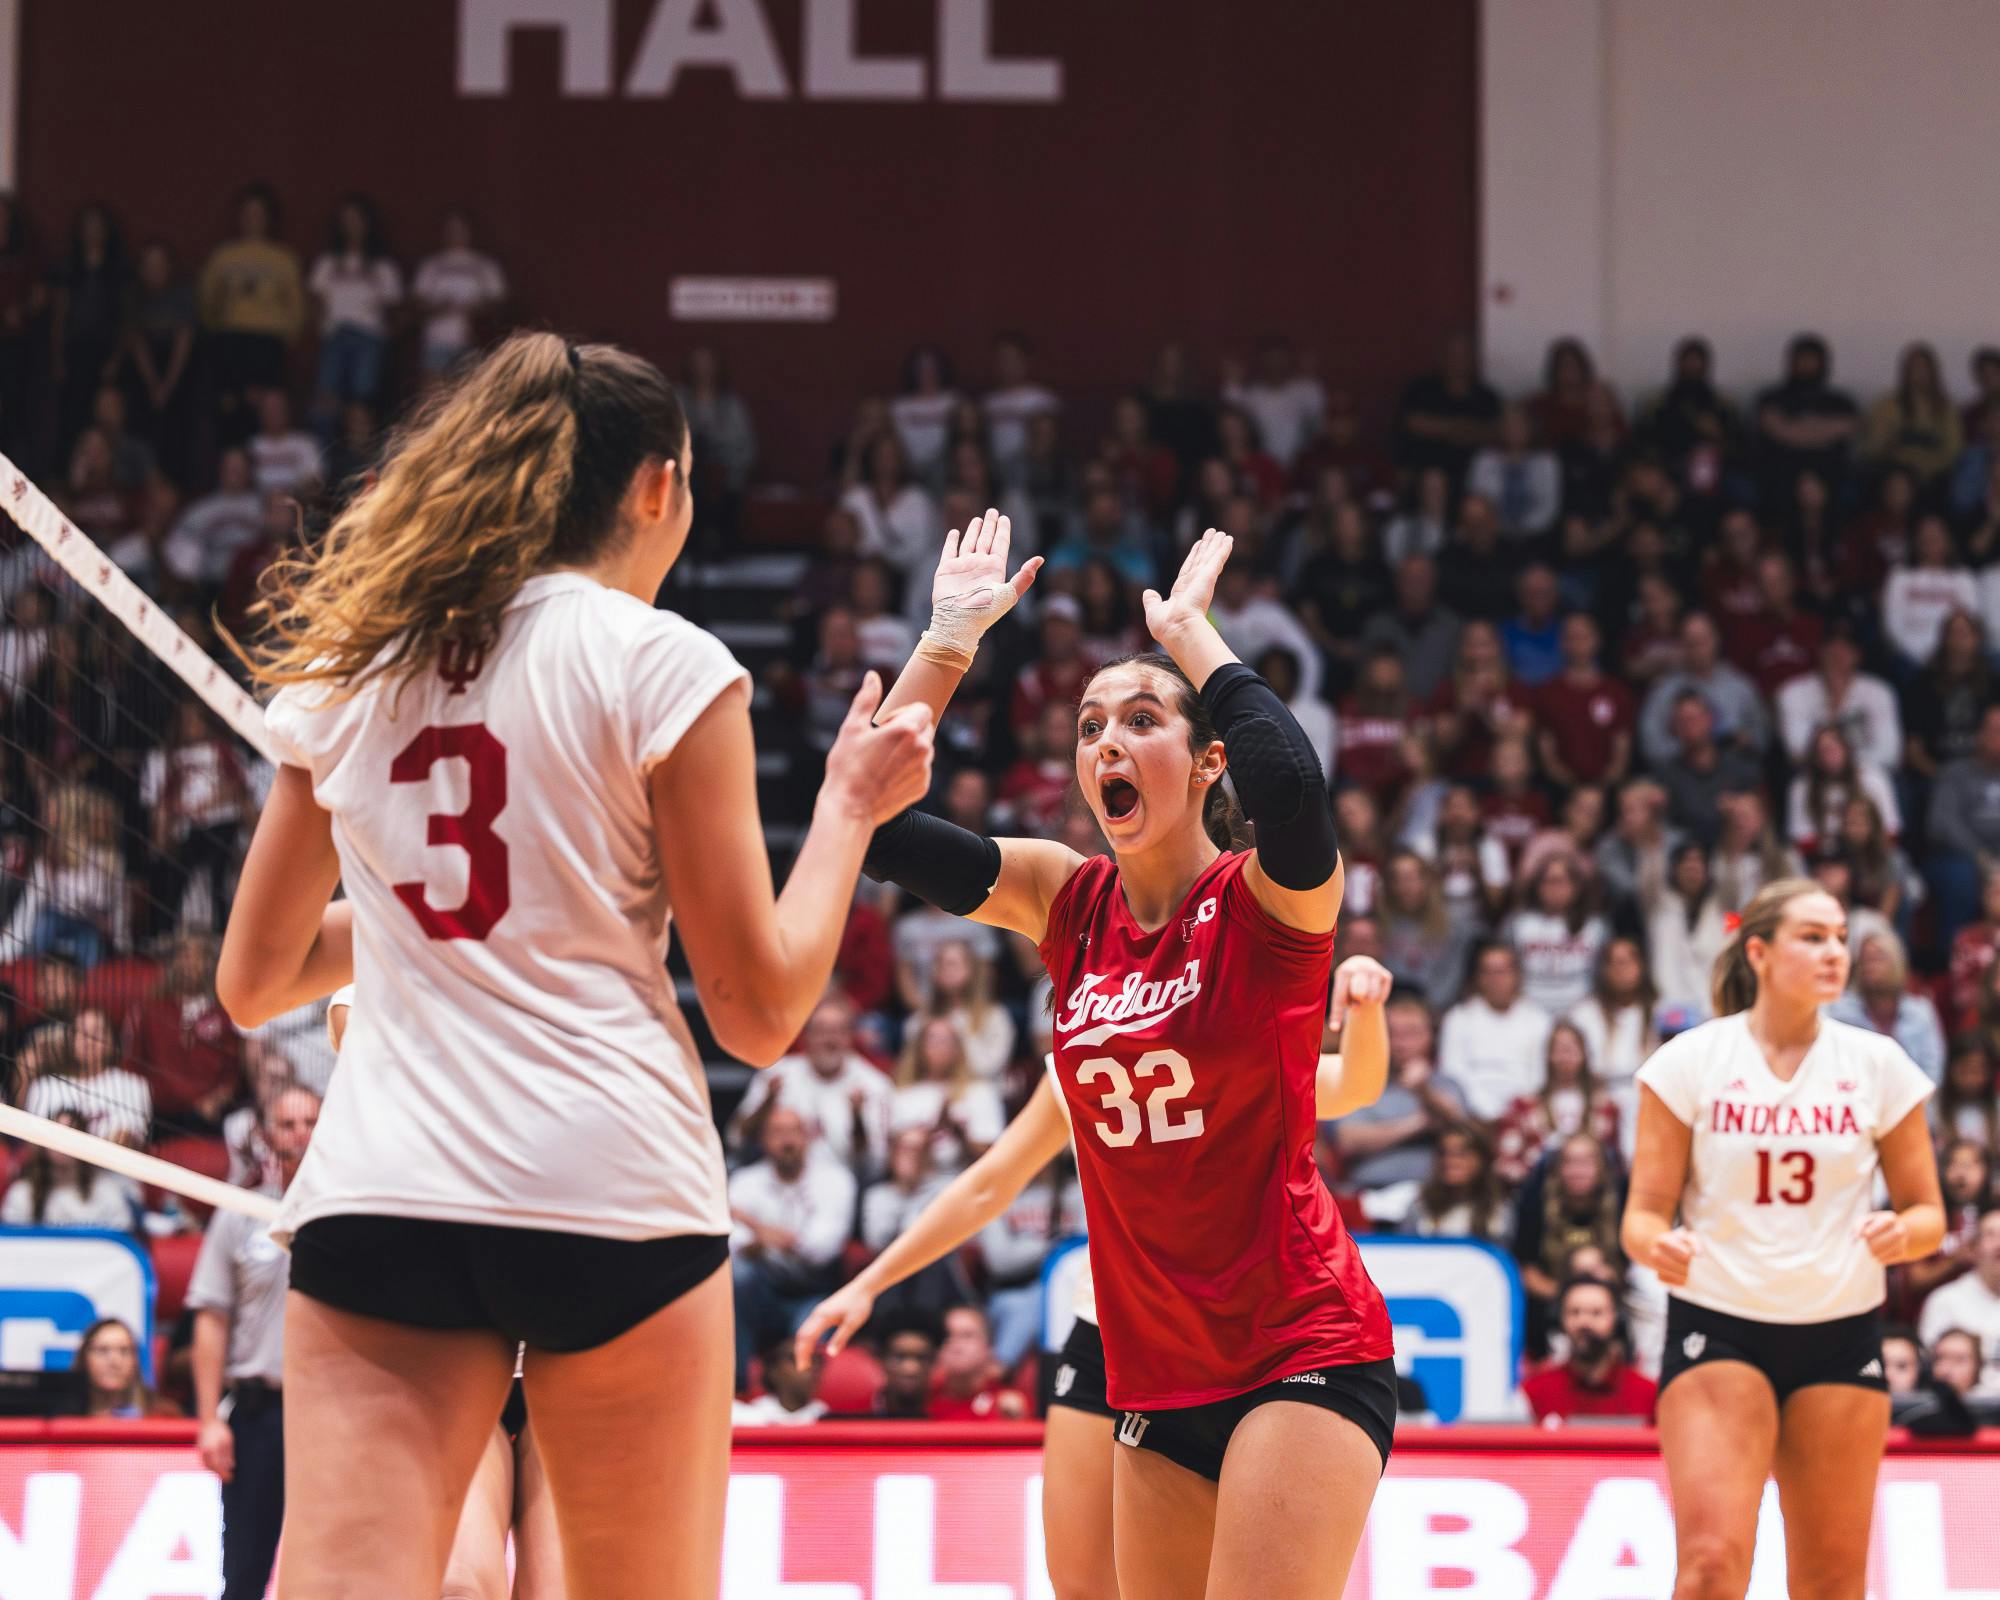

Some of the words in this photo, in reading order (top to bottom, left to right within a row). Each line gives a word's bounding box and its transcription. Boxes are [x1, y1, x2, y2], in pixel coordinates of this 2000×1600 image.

[459, 0, 1061, 97] HALL
[389, 722, 510, 941] 3
[1076, 1049, 1205, 1148] 32
[1712, 1100, 1859, 1134] INDIANA
[1754, 1149, 1816, 1205] 13
